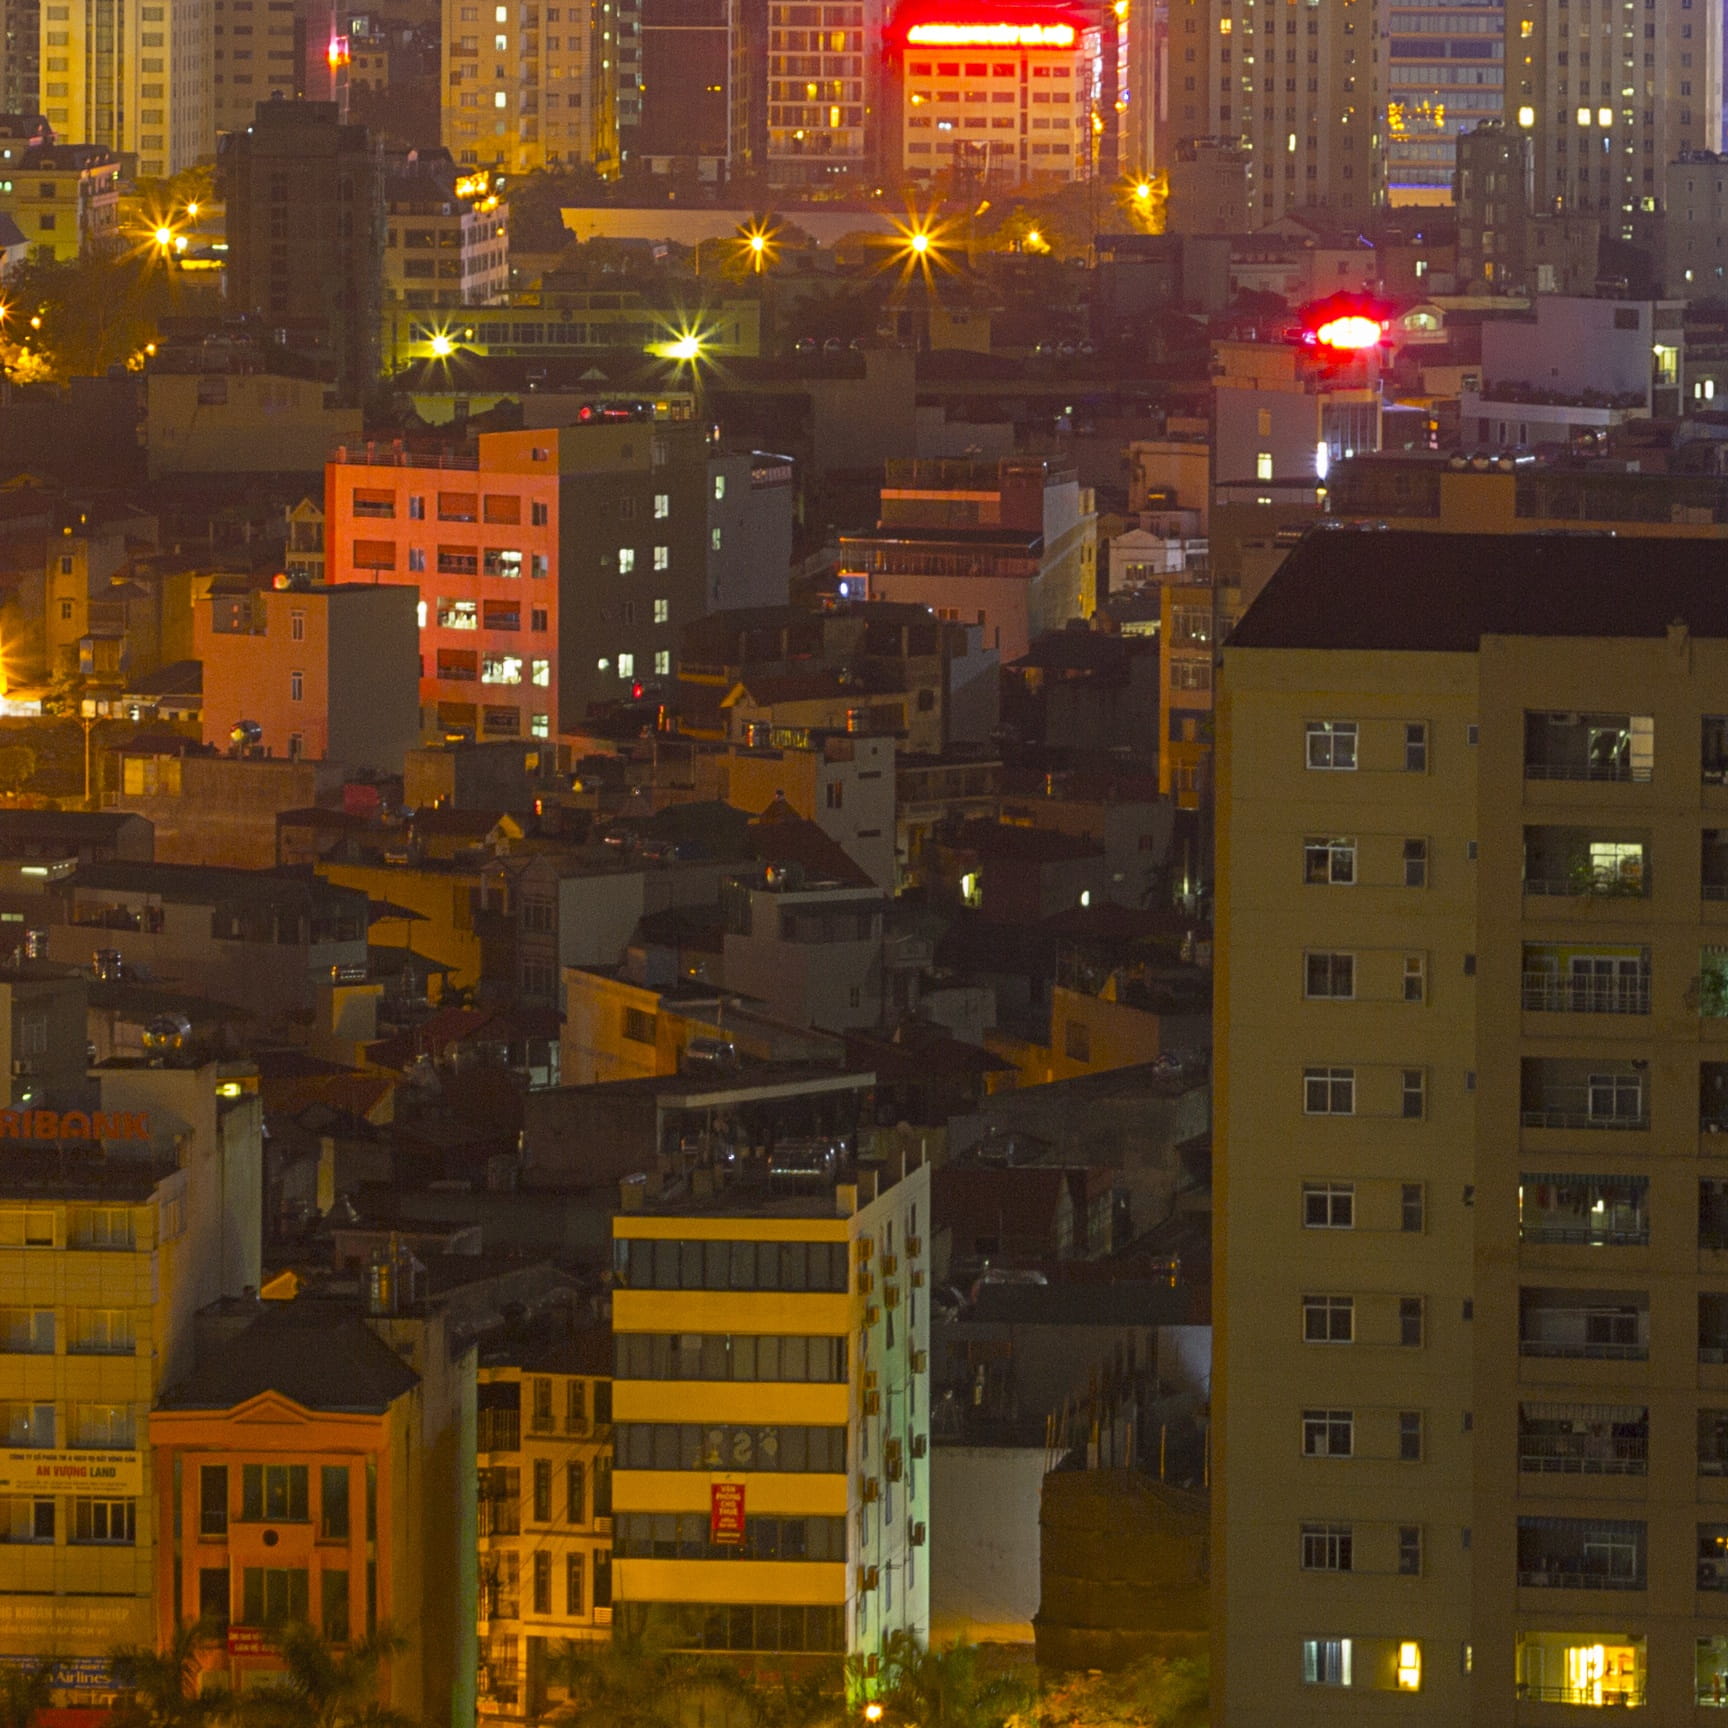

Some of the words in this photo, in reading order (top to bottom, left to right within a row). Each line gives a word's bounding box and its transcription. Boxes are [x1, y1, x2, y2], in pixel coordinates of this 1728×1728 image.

[36, 1465, 51, 1477] AN
[89, 1467, 117, 1478] LAND
[57, 1671, 113, 1684] Airlines
